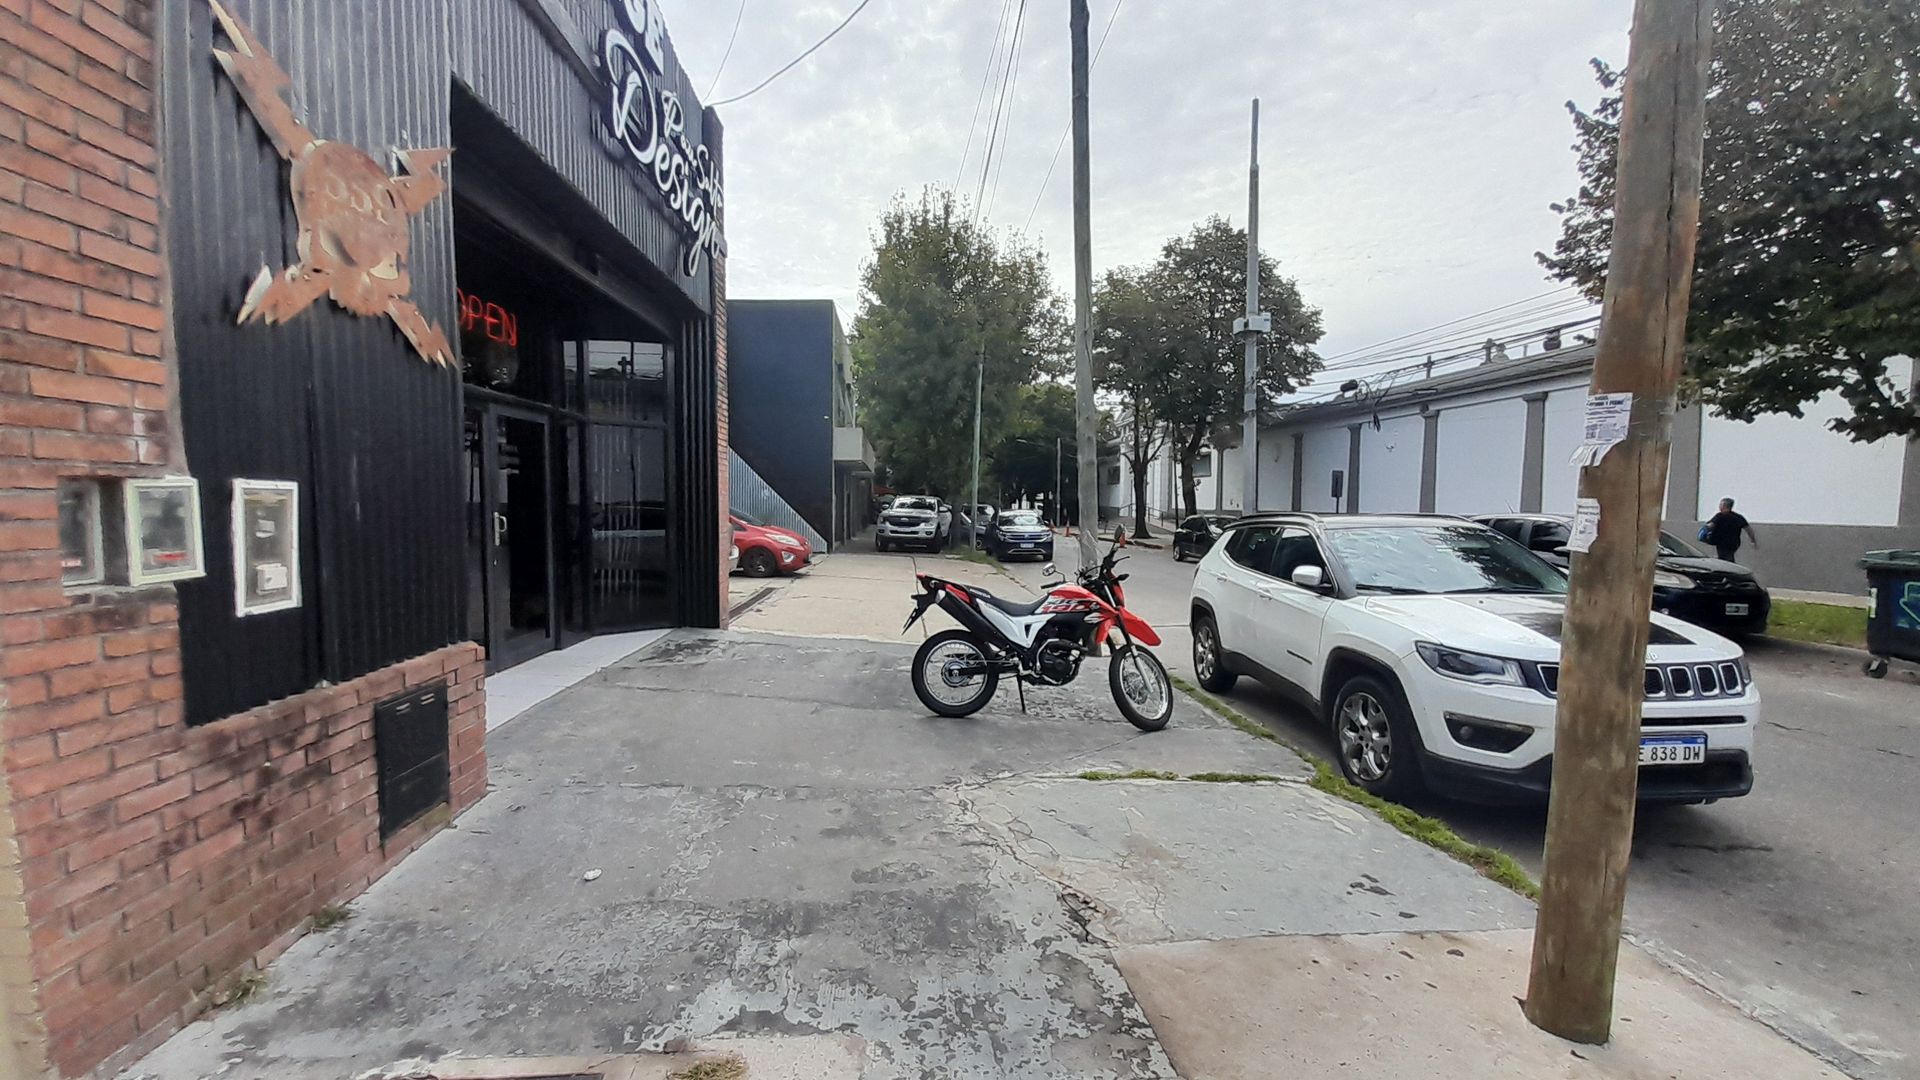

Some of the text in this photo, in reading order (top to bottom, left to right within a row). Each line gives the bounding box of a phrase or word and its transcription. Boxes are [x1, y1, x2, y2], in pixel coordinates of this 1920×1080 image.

[606, 28, 720, 277] Design
[1650, 746, 1677, 761] 838
[1683, 746, 1701, 761] DW
